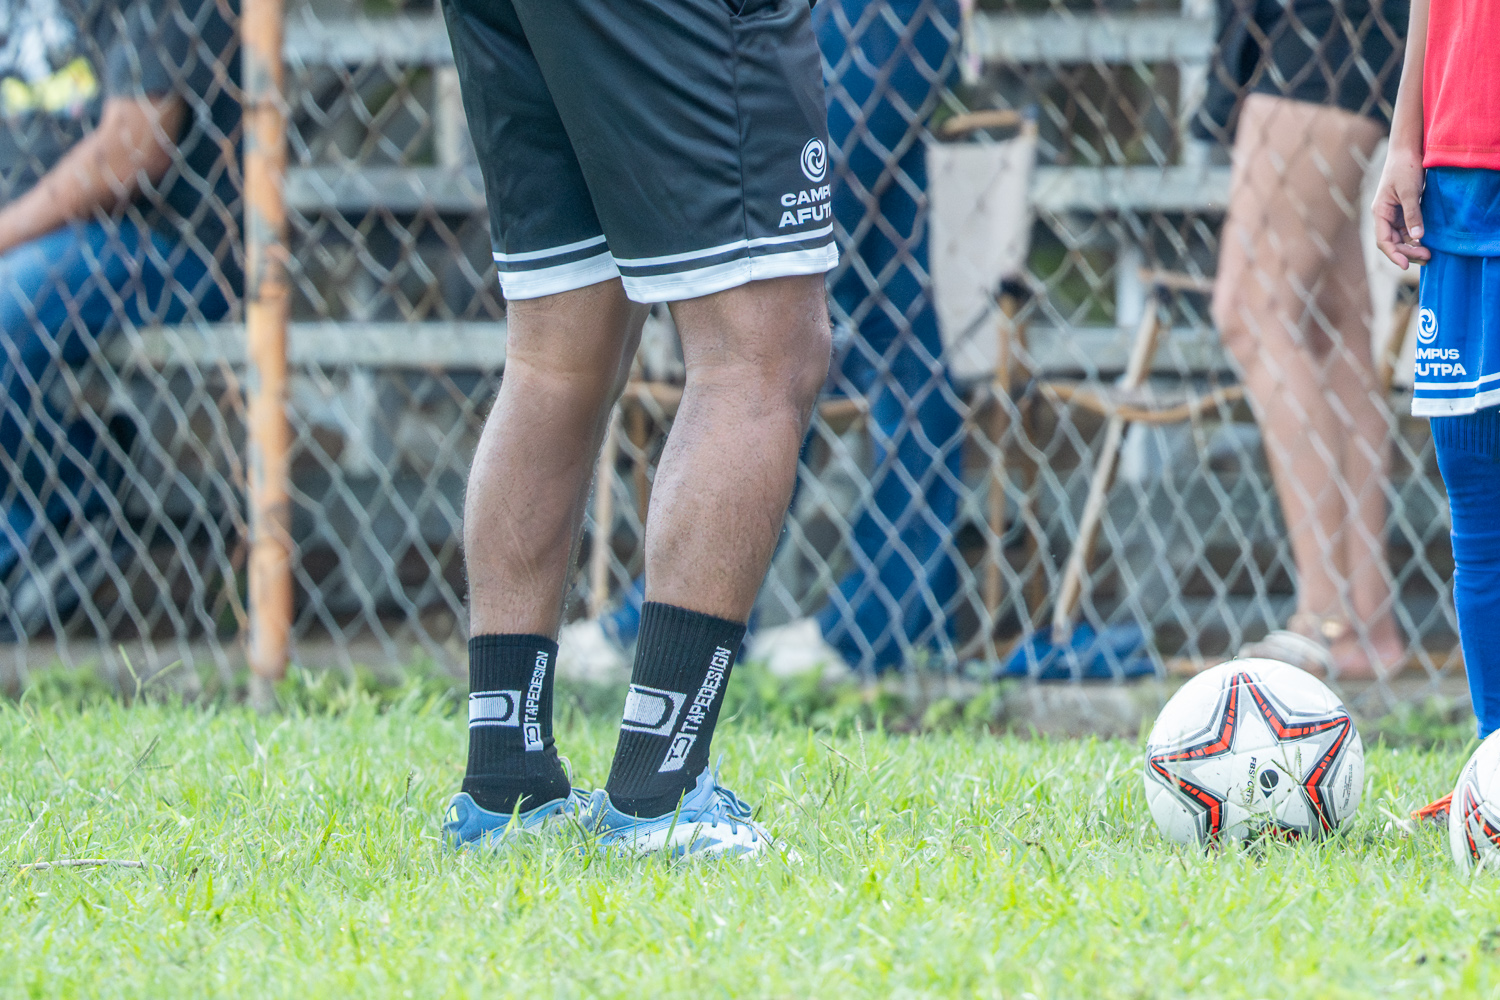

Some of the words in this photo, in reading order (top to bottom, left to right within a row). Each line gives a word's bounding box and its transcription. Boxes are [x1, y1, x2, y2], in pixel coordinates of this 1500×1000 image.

[779, 201, 832, 228] AFUT
[780, 184, 831, 207] CAMP
[524, 650, 549, 722] TAPEDESIGN
[681, 645, 732, 733] TAPEDESIGN
